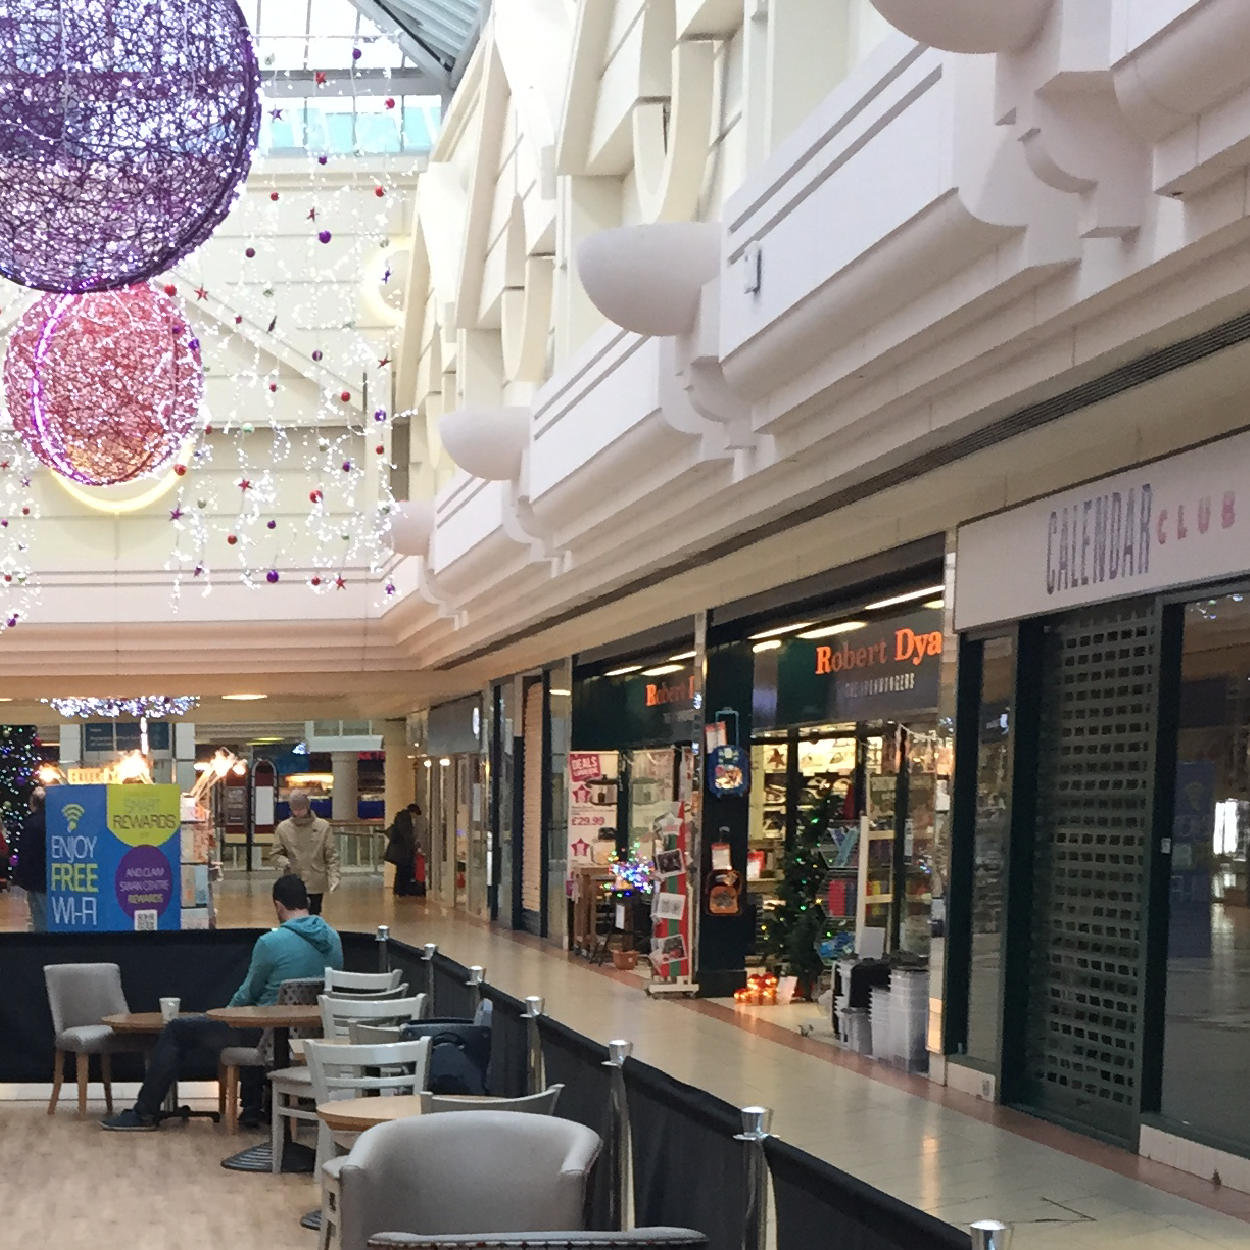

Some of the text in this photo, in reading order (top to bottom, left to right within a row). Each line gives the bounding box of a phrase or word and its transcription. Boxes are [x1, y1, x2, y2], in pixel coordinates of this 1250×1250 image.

[1046, 483, 1237, 595] CALENDAR CLUB
[814, 637, 888, 675] Robert
[571, 756, 598, 770] DEALS
[112, 814, 177, 830] REWARDS
[571, 817, 605, 826] £29.99
[51, 835, 98, 863] ENJOY
[51, 863, 99, 893] FREE
[51, 896, 98, 926] WI-FI
